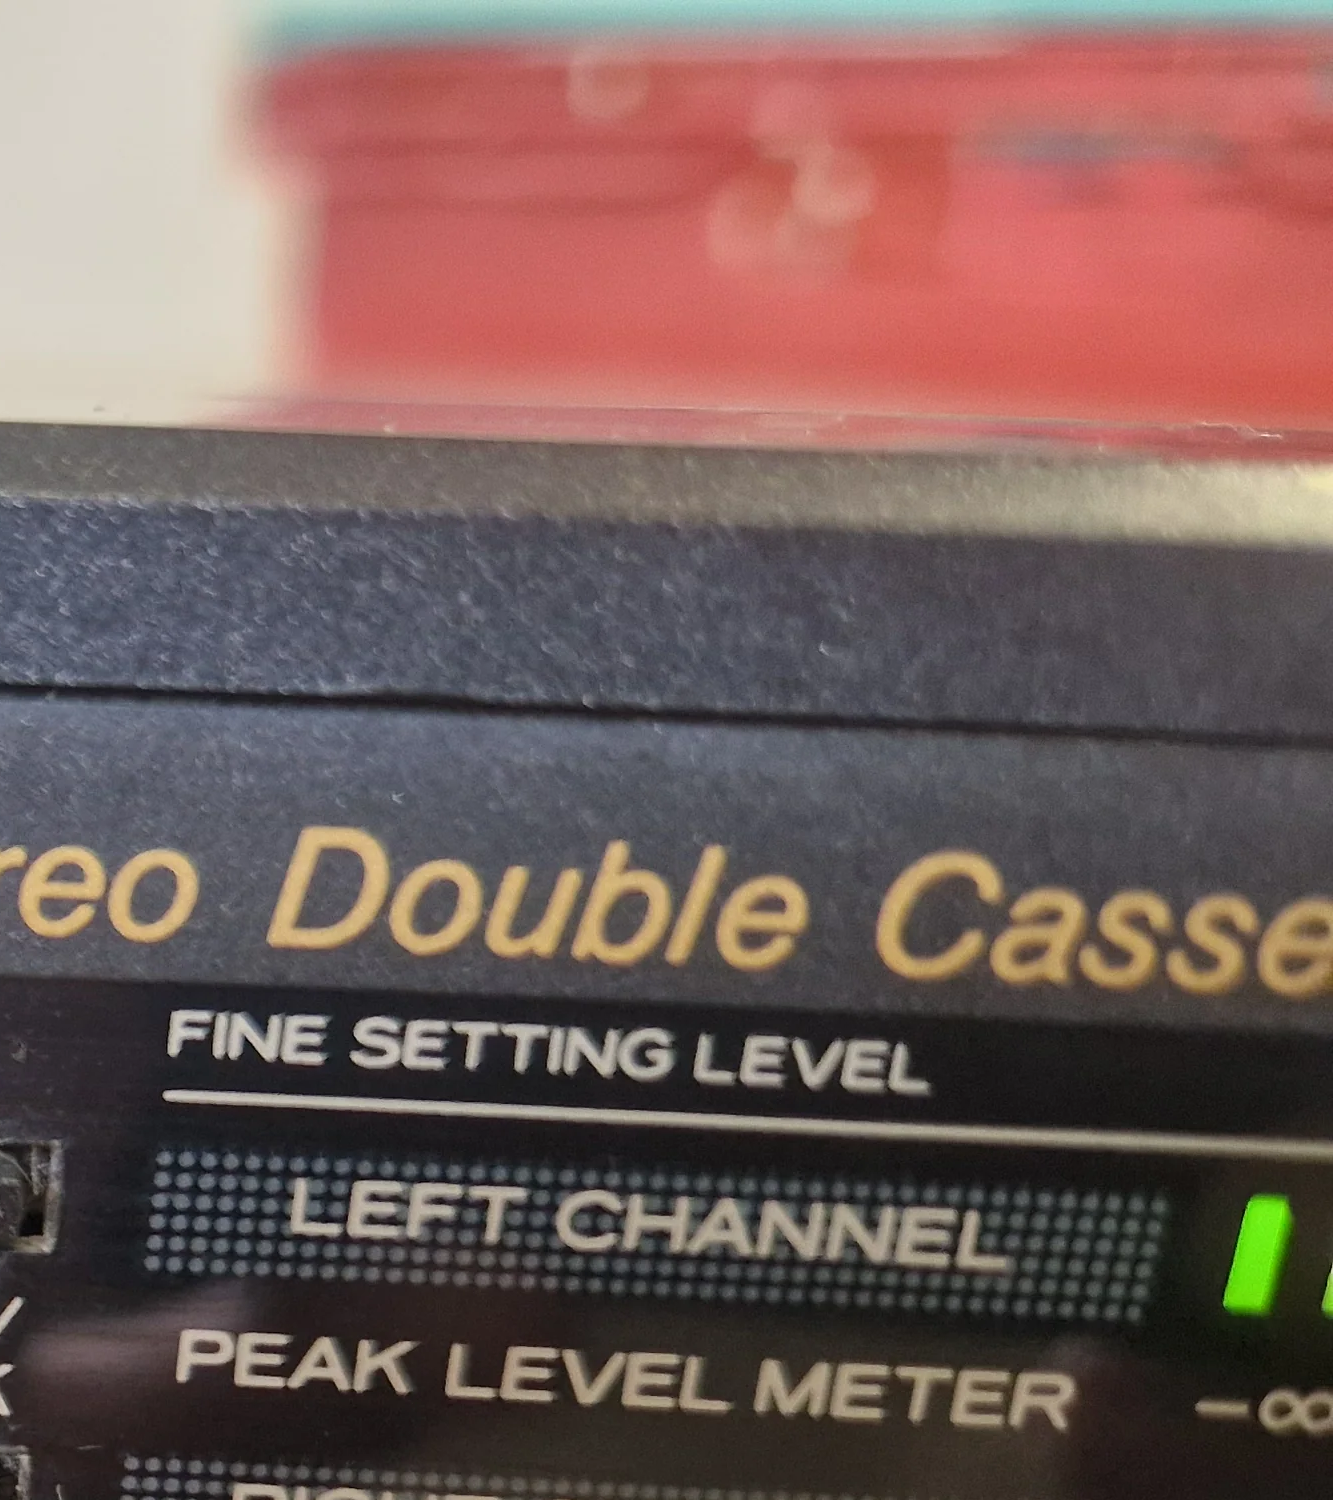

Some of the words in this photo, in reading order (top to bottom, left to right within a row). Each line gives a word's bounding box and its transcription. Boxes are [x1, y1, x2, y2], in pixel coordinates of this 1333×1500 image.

[266, 825, 811, 971] Double
[876, 848, 1333, 997] Casse
[167, 1008, 331, 1066] FINE
[349, 1016, 677, 1084] SETTING
[693, 1029, 933, 1098] LEVEL
[287, 1177, 536, 1246] LEFT
[554, 1190, 1012, 1275] CHANNEL
[175, 1327, 423, 1396] PEAK
[444, 1341, 732, 1416] LEVEL
[754, 1356, 1077, 1432] METER
